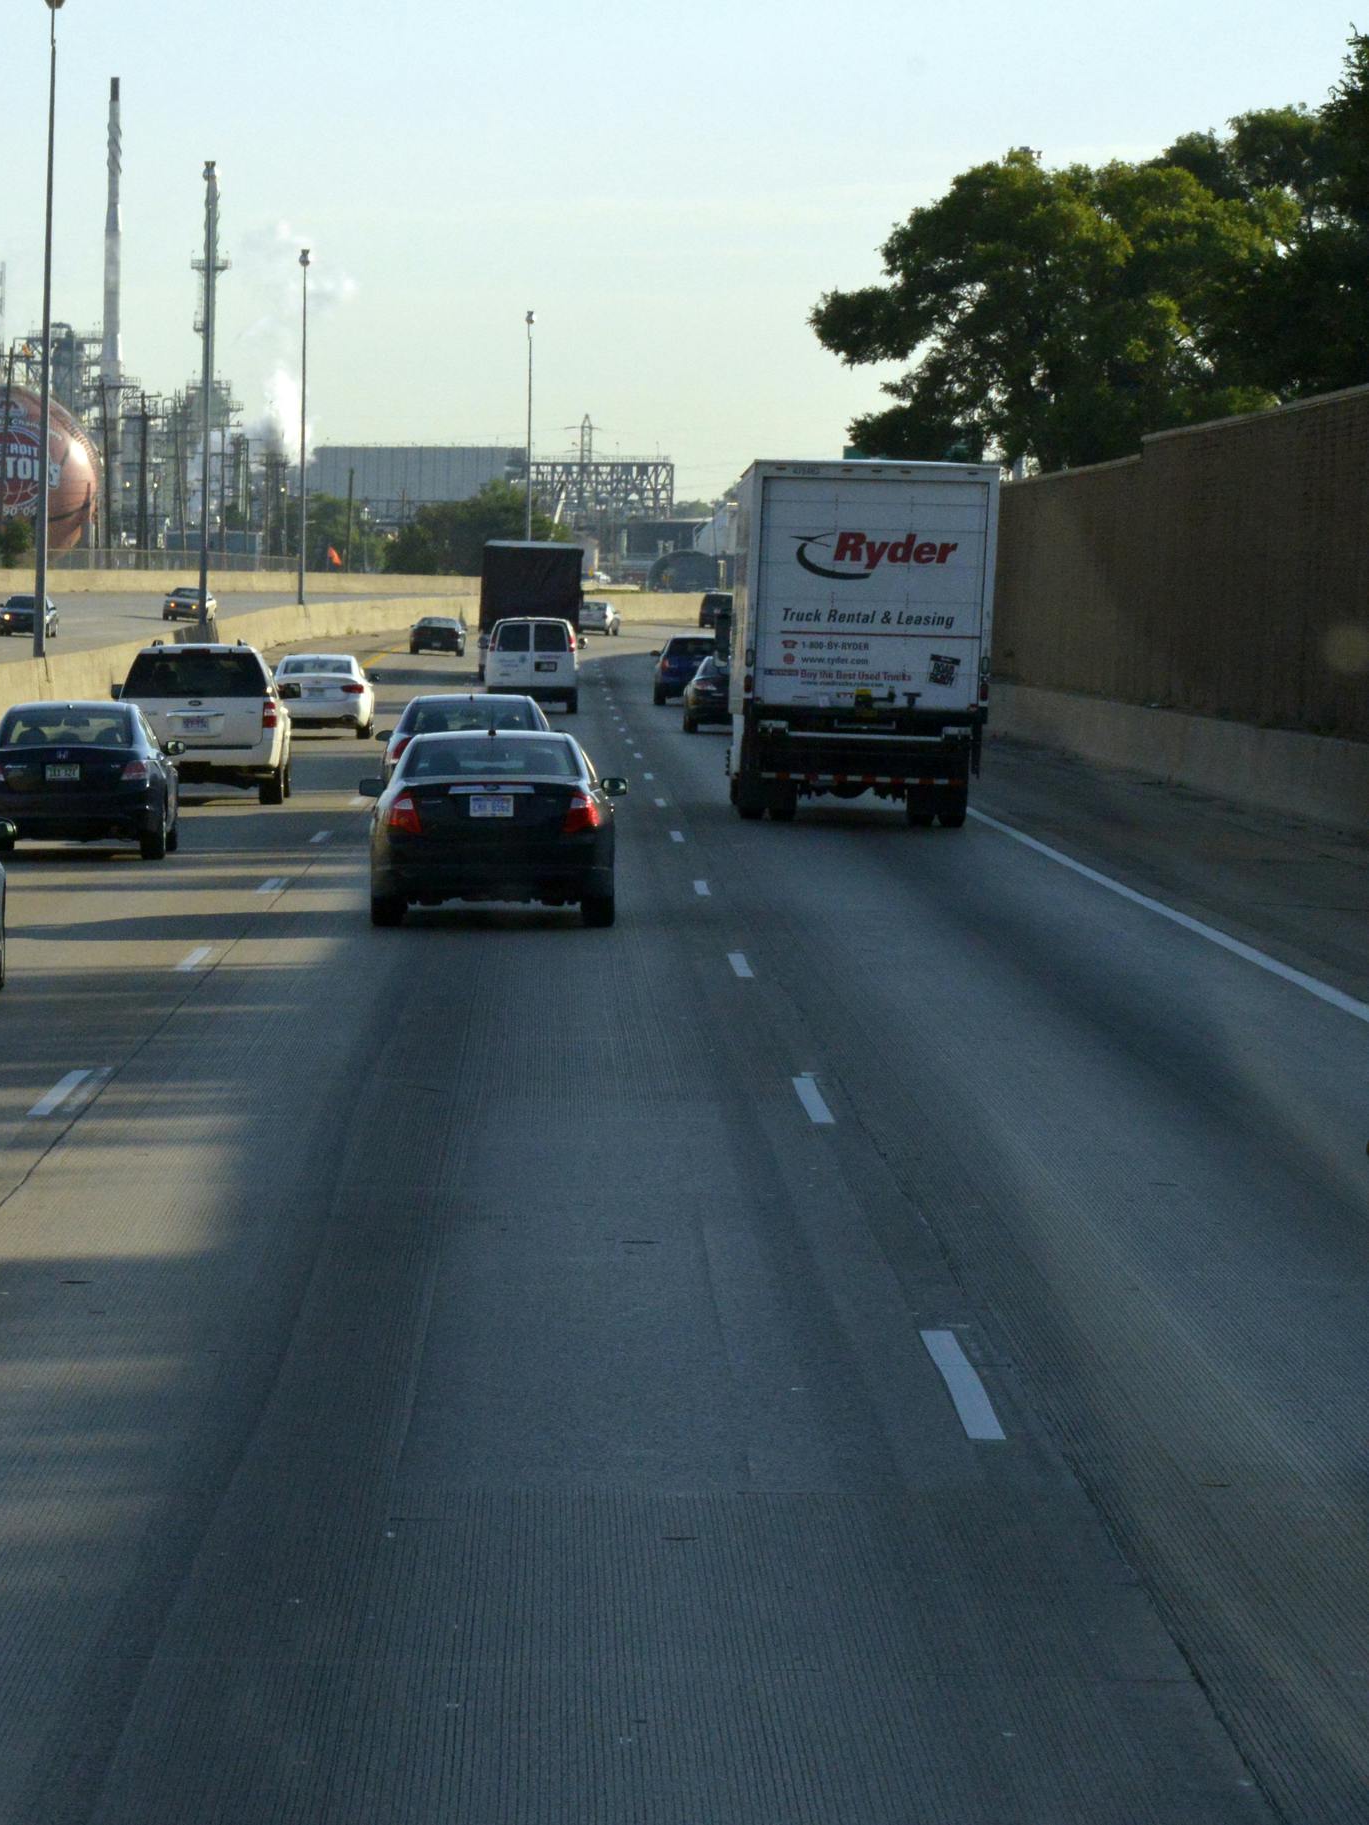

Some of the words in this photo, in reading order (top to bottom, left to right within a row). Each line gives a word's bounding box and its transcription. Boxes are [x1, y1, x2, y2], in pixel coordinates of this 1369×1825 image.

[833, 532, 959, 570] Ryder
[782, 607, 823, 623] Truck
[827, 609, 876, 625] Rental
[881, 611, 892, 625] &
[897, 611, 955, 630] Leasing
[801, 655, 870, 666] www.ryder.com
[800, 669, 818, 681] Buy
[819, 670, 834, 680] the
[836, 670, 856, 680] Best
[858, 671, 880, 681] Used
[883, 671, 911, 682] Trucks
